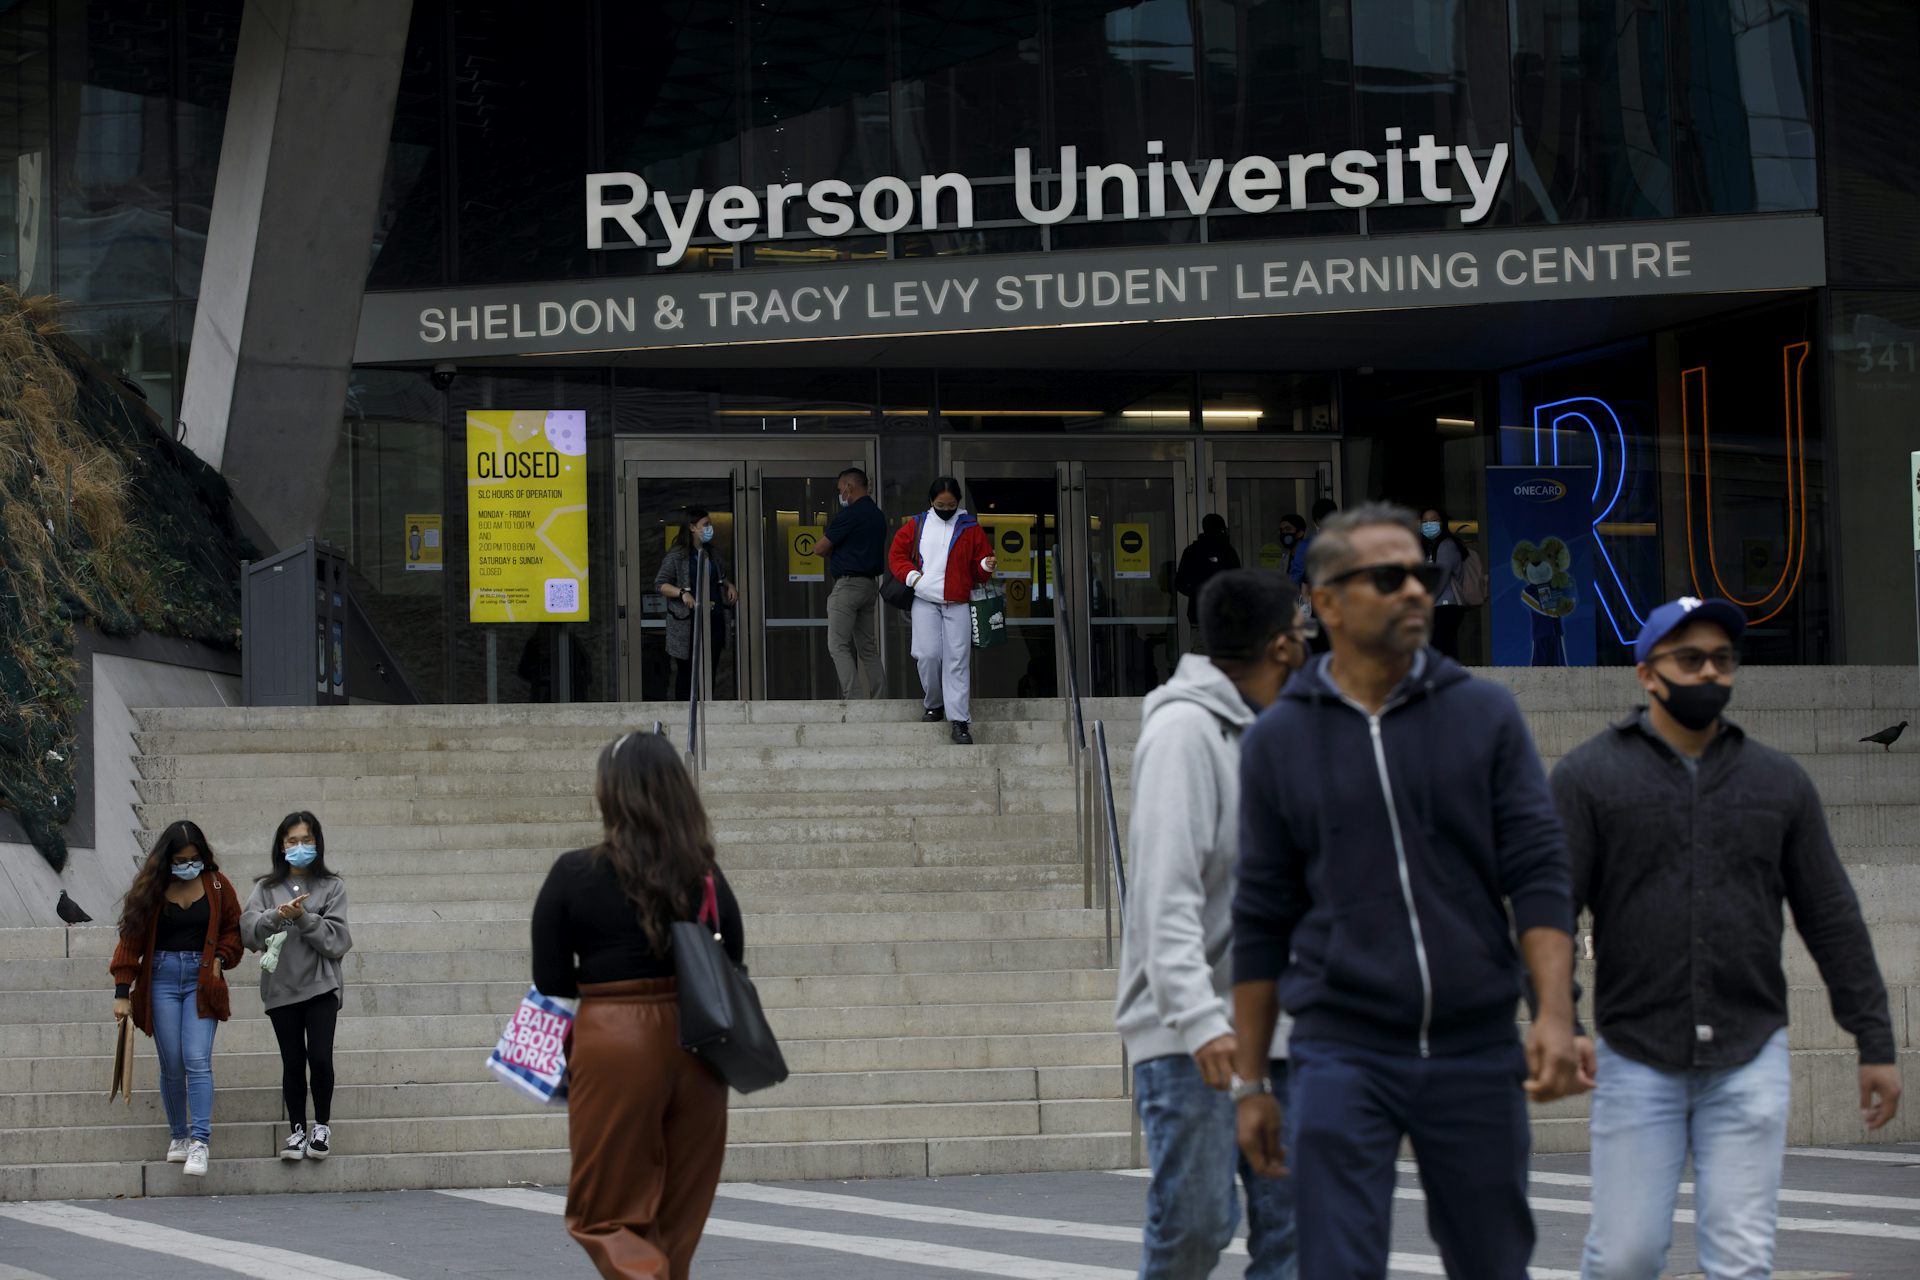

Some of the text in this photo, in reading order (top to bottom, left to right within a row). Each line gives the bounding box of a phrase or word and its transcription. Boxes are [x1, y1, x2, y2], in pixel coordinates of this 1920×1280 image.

[586, 127, 1508, 266] Ryerson University
[419, 241, 1690, 344] SHELDON & TRACY LEVY STUDENT LEARNING CENTRE
[478, 452, 559, 478] CLOSED
[478, 489, 562, 499] SLC HOURS OF OPERATION
[1513, 485, 1563, 496] ONECARD
[478, 510, 504, 519] MONDAY
[510, 510, 531, 519] FRIDAY
[493, 521, 503, 530] AM
[504, 521, 512, 530] TO
[526, 521, 535, 530] PM
[479, 532, 492, 540] AND
[493, 543, 502, 552] PM
[504, 543, 511, 552] TO
[526, 543, 536, 552] PM
[479, 556, 511, 565] SATURDAY
[519, 556, 544, 565] SUNDAY
[480, 568, 502, 576] CLOSED
[516, 1006, 567, 1037] BATH
